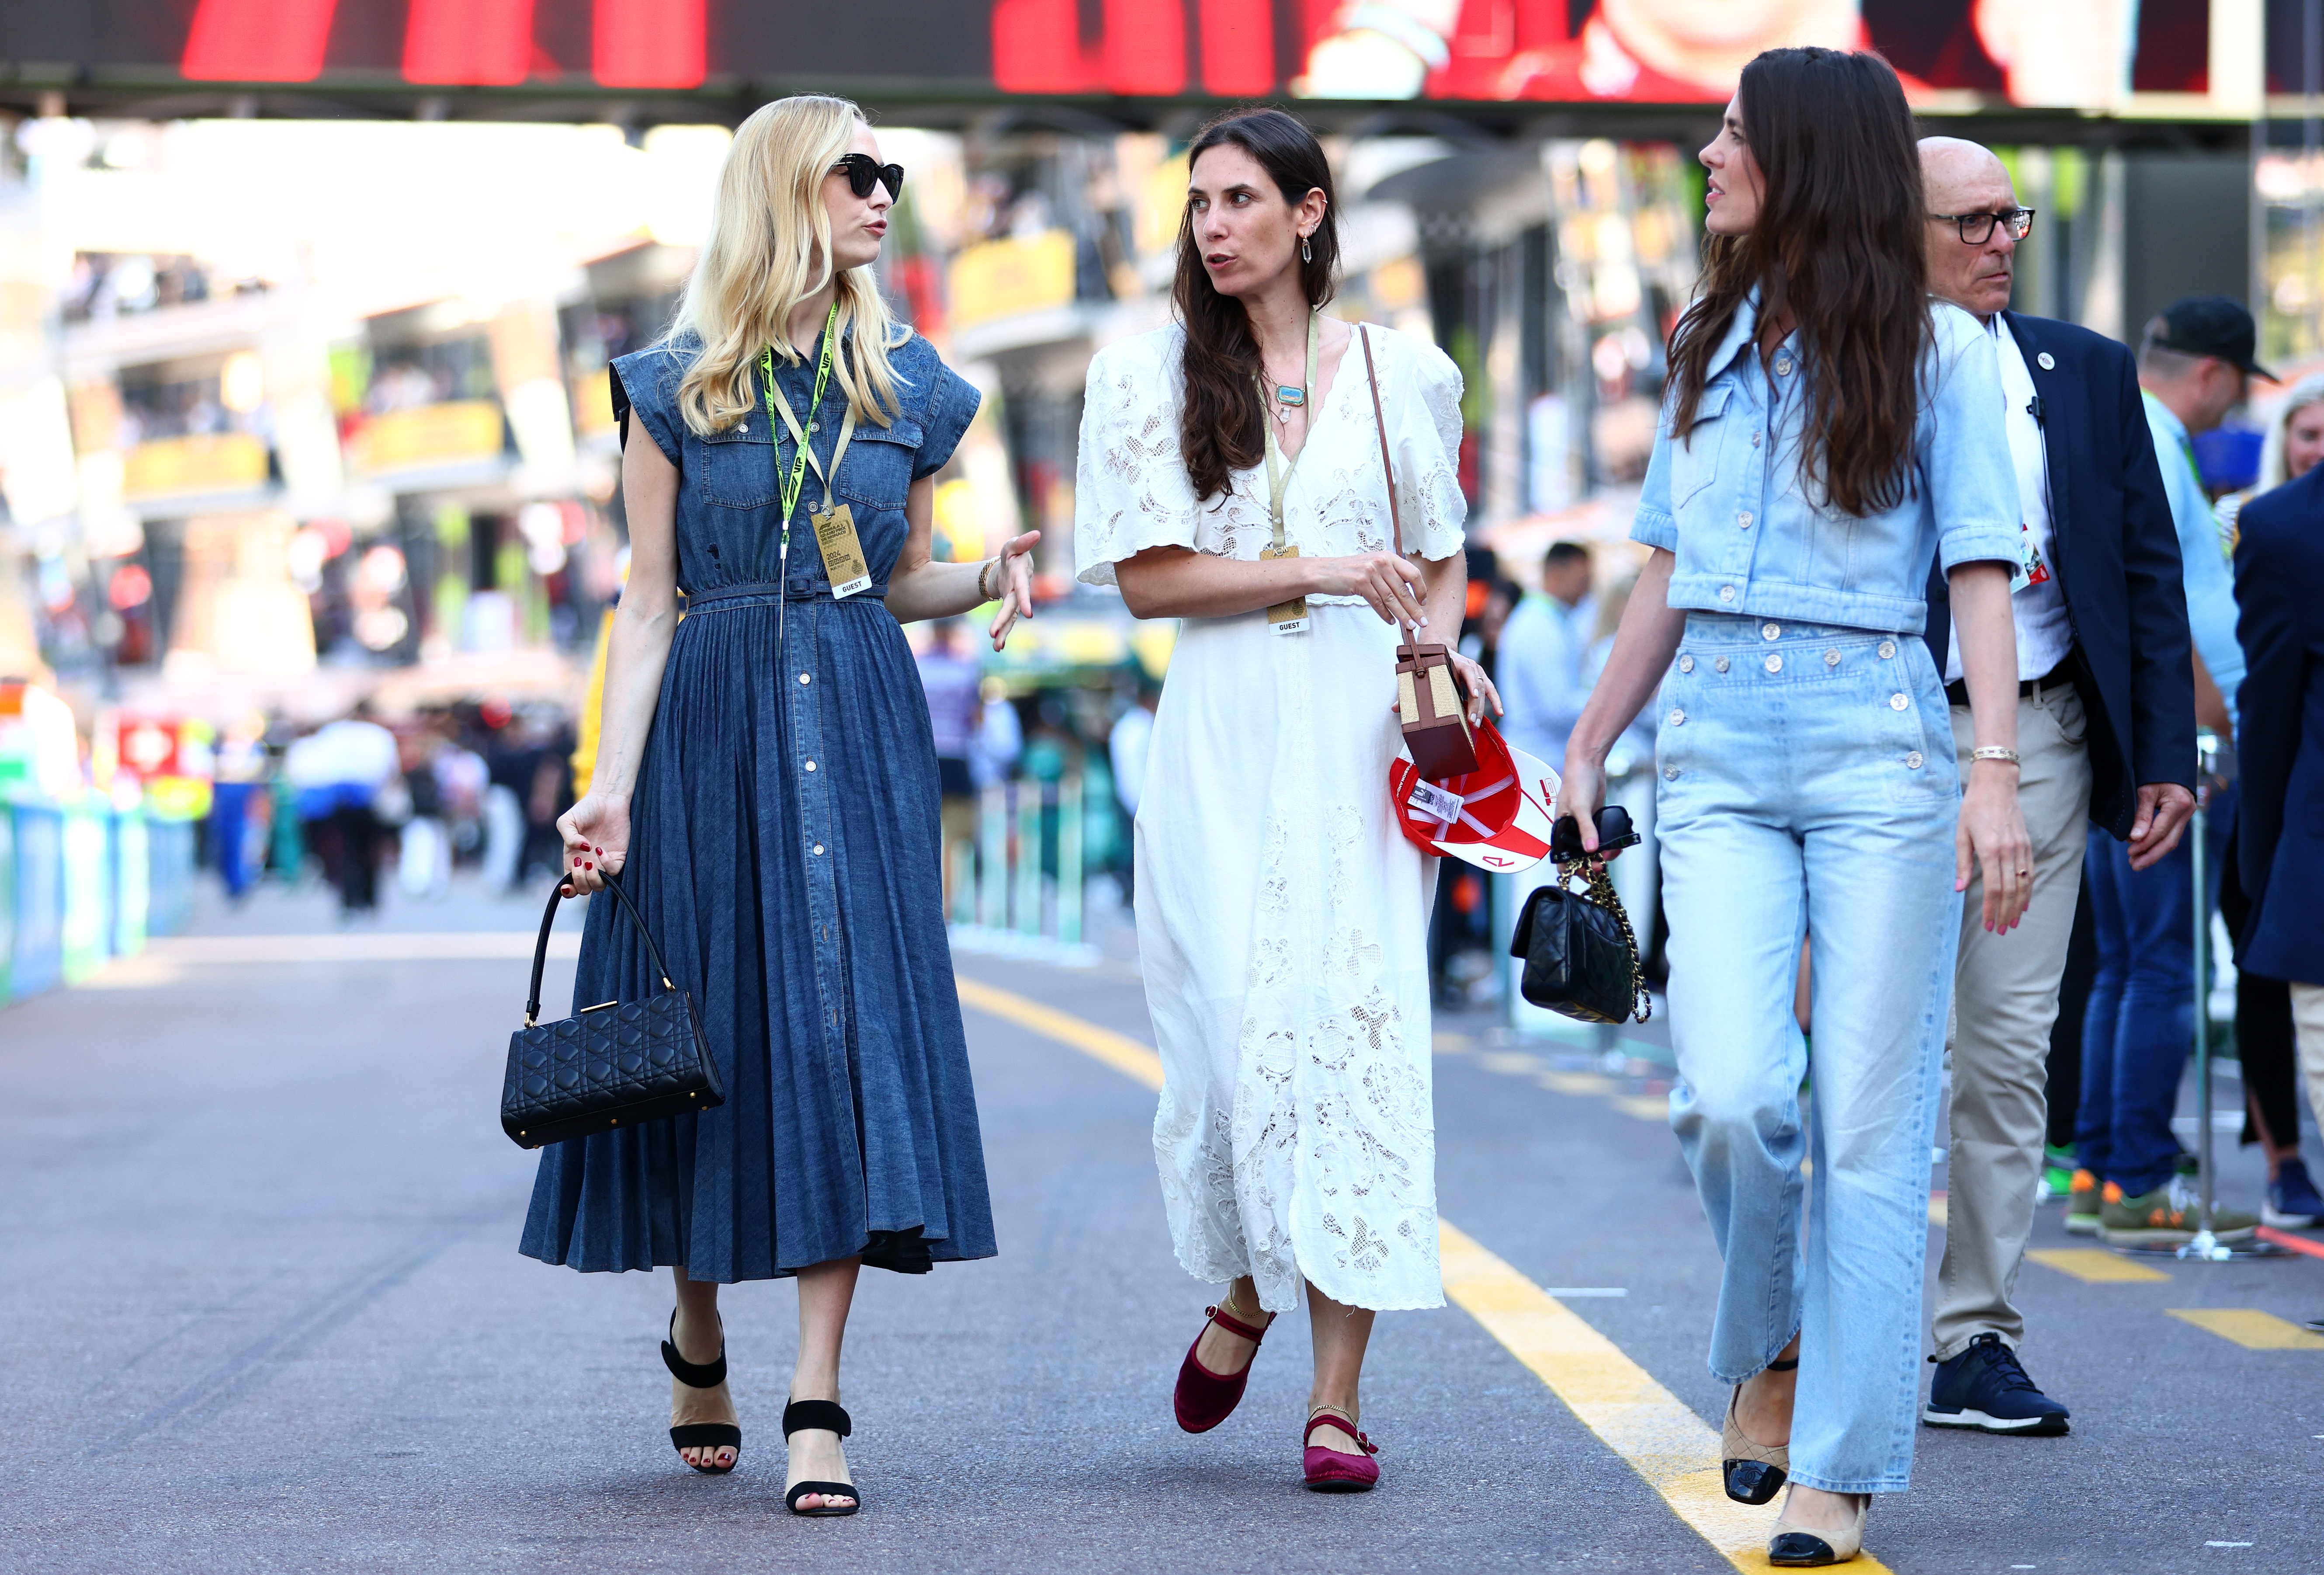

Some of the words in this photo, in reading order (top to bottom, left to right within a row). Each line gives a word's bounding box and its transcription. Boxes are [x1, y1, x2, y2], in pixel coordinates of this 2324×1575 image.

[822, 353, 831, 369] VIP
[839, 422, 851, 450] MONACO
[794, 457, 803, 473] VIP
[819, 524, 840, 534] FORMULA
[819, 529, 836, 538] GRAND
[827, 530, 846, 539] MONACO
[826, 550, 841, 560] 2024
[843, 581, 862, 592] GUEST
[1401, 763, 1413, 782] PASSION
